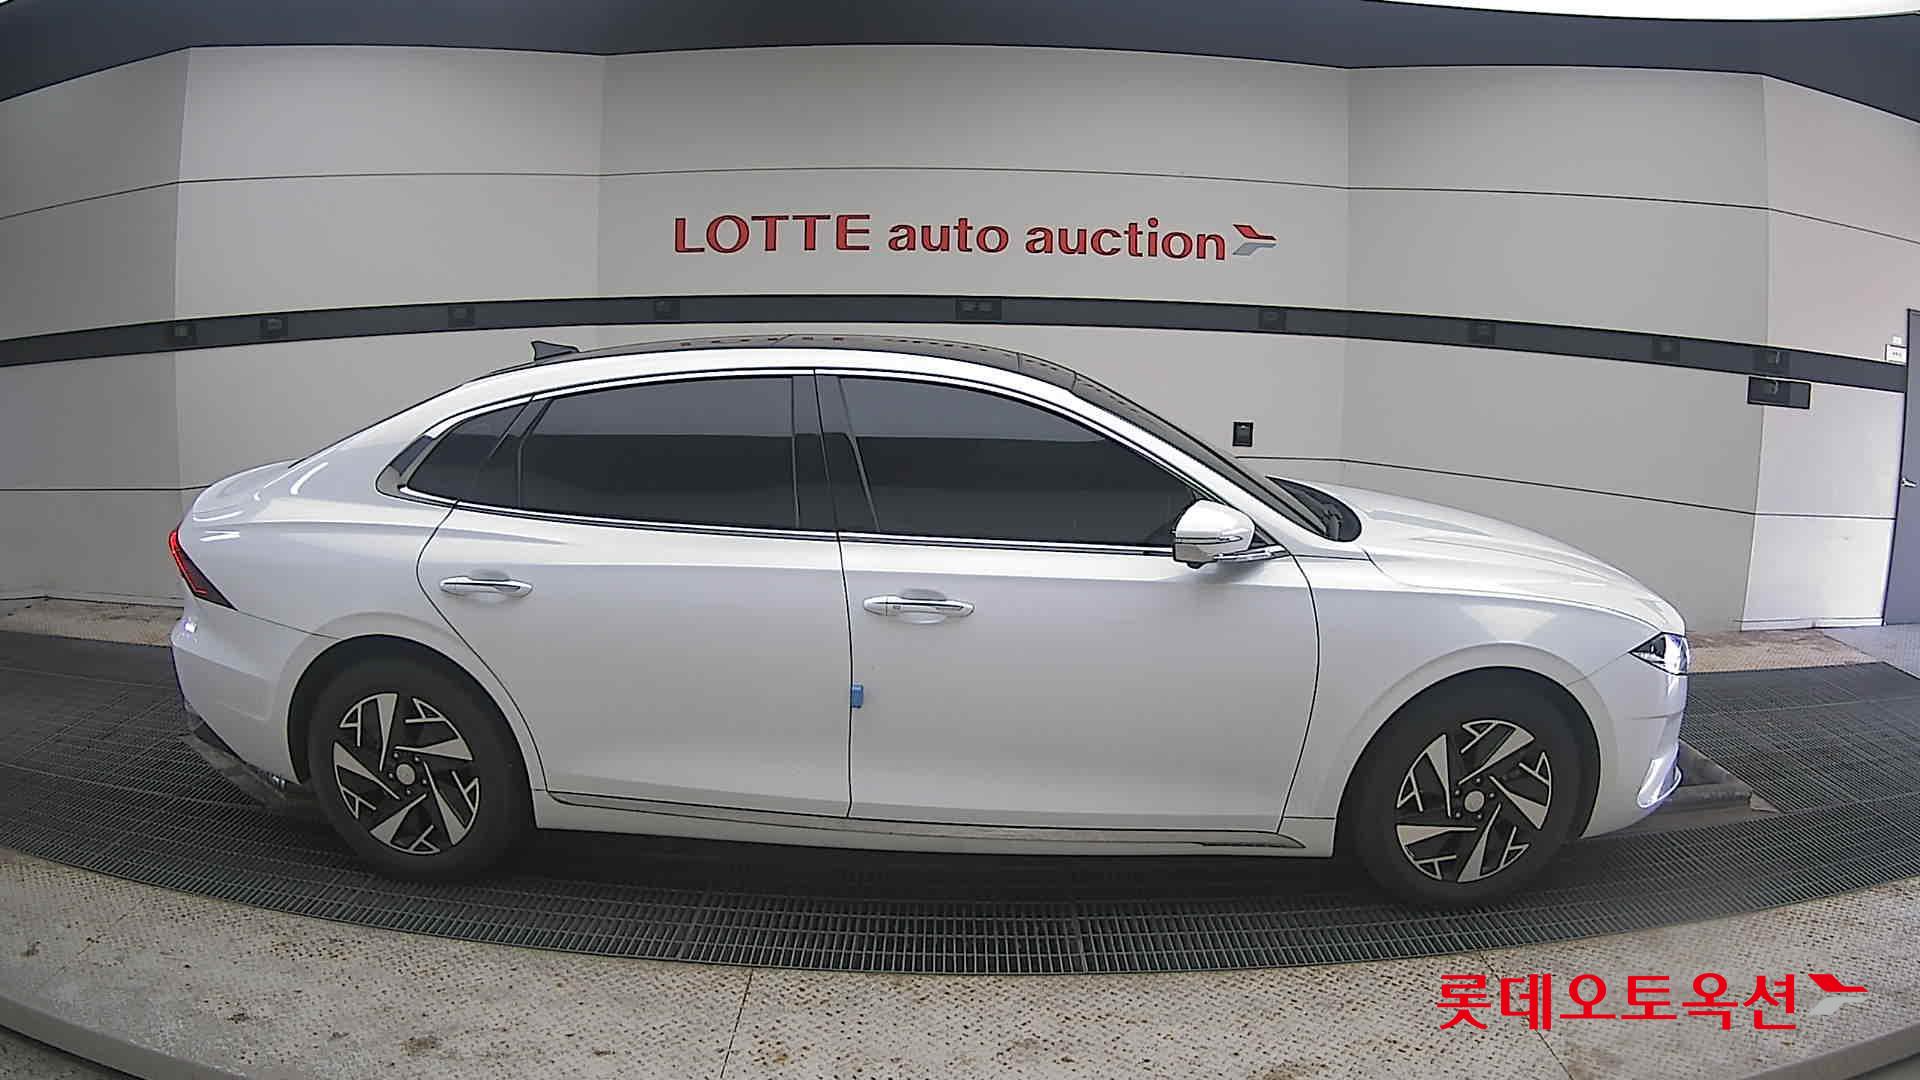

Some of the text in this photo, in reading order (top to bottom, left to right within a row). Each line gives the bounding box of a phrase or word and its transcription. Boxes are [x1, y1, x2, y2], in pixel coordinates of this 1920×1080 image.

[674, 214, 1226, 261] LOTTE auto auction
